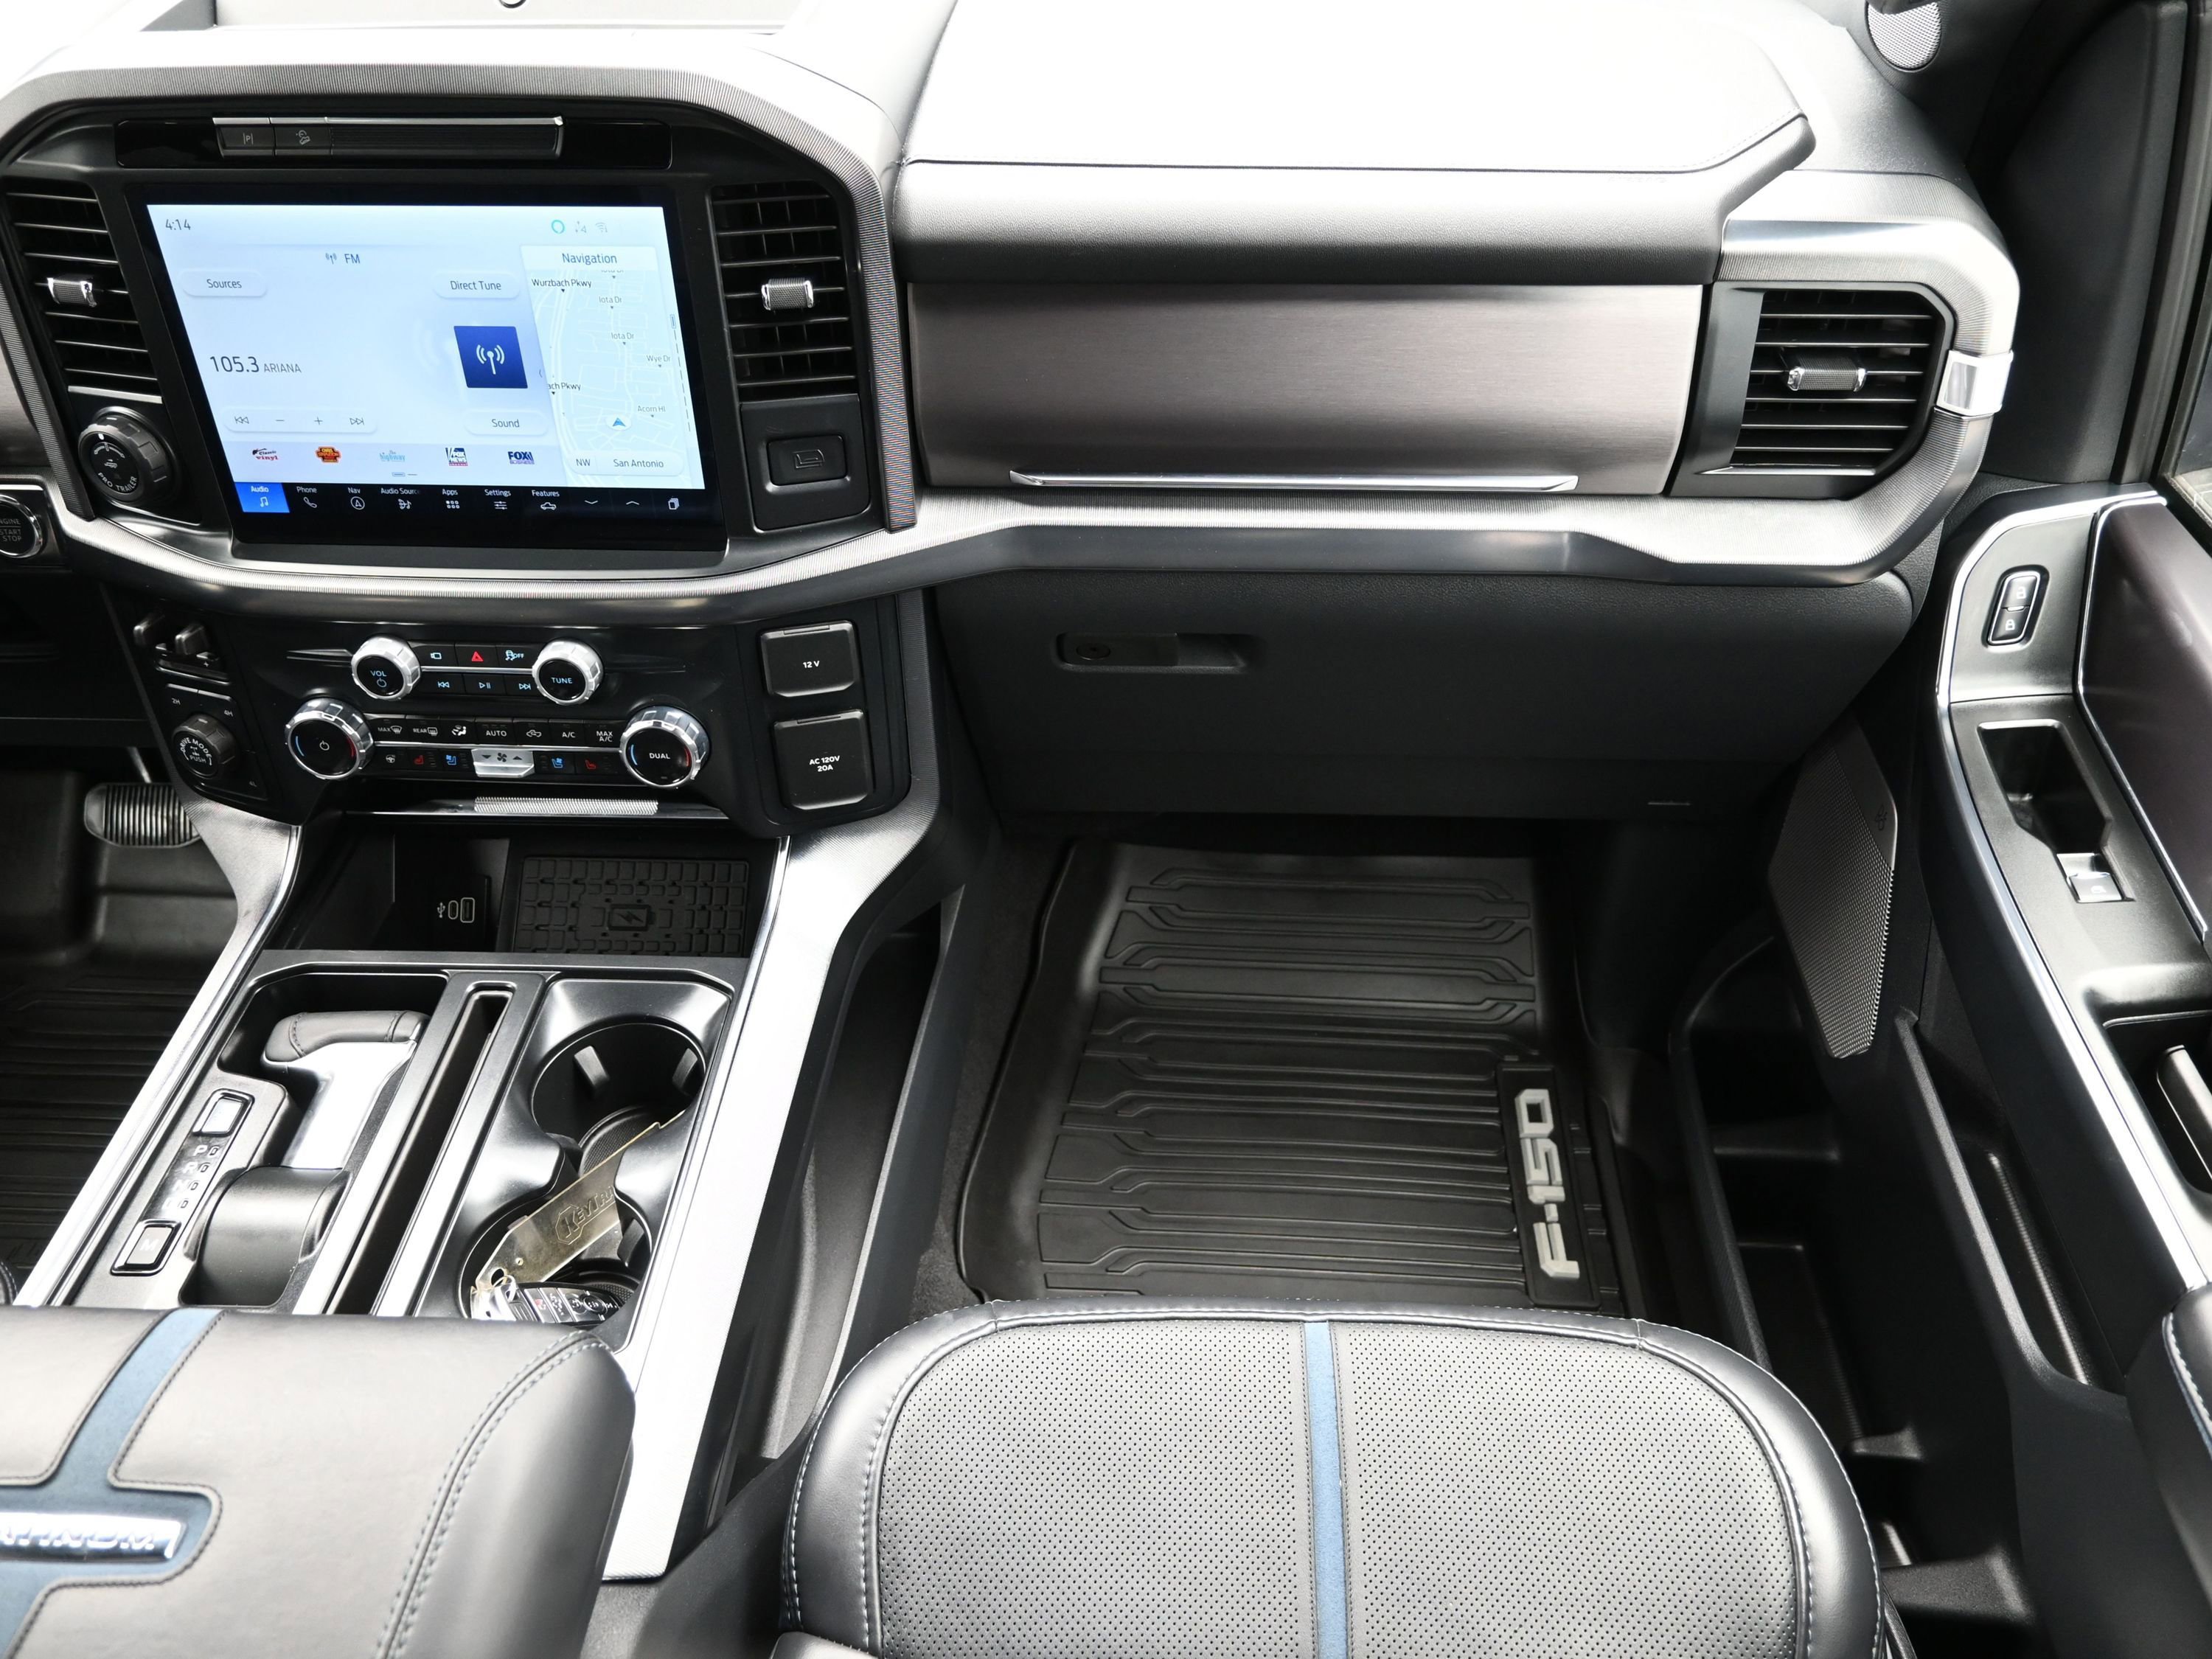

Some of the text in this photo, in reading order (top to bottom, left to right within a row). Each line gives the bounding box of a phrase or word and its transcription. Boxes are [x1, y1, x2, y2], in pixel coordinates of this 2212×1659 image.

[165, 218, 192, 231] 4:14
[344, 253, 361, 265] FM
[562, 252, 618, 265] Navigation
[206, 278, 243, 289] Sources
[450, 280, 501, 291] Direct Tune
[531, 278, 592, 288] Wurzbach Pkwy
[599, 296, 613, 304] Iota
[611, 332, 626, 340] Iota
[646, 355, 662, 363] Wye
[209, 355, 302, 374] 105.3 ARIANA
[560, 382, 581, 391] Pkwy
[637, 405, 658, 413] Acorn
[491, 418, 520, 428] Sound
[507, 451, 530, 461] FOX
[576, 458, 591, 467] NW
[613, 458, 664, 468] San Antonio
[98, 472, 114, 487] PRO
[116, 476, 138, 493] TRAILER
[251, 485, 269, 493] Audio
[296, 486, 317, 494] Phone
[442, 488, 459, 496] Apps
[484, 488, 512, 498] Settings
[532, 490, 560, 498] Features
[180, 737, 212, 758] DRIVE MODE
[189, 754, 207, 763] PUSH
[809, 755, 841, 765] AC 120V
[817, 764, 834, 772] 20A
[192, 1144, 208, 1157] P
[182, 1161, 198, 1173] R
[1514, 1088, 1580, 1279] F-150
